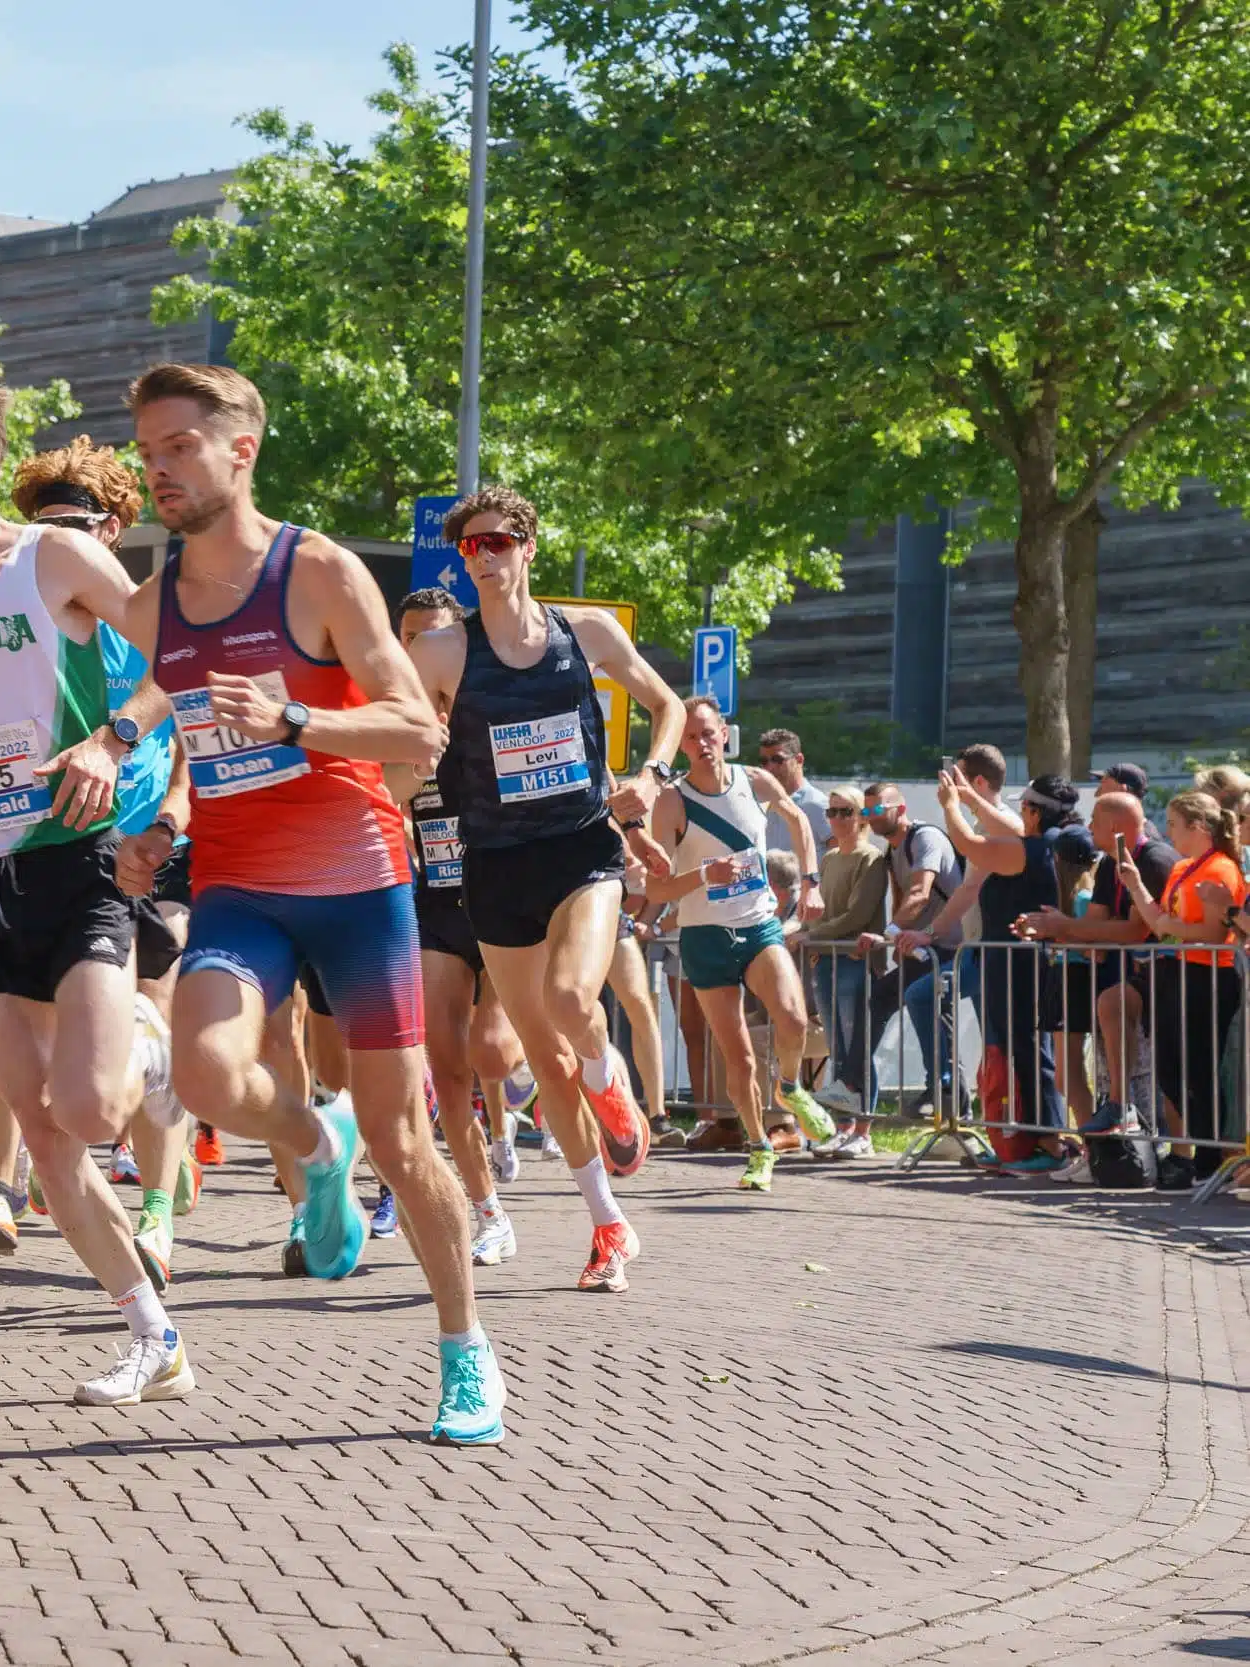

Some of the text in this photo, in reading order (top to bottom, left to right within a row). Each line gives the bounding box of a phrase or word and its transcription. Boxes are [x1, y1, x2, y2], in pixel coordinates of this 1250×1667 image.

[703, 635, 724, 680] P
[0, 741, 30, 757] 2022
[211, 726, 258, 752] 10
[495, 727, 575, 750] VENLOOP 2022
[525, 748, 558, 765] Levi
[214, 757, 274, 781] Daan
[521, 767, 569, 792] M151
[422, 831, 456, 840] VENLOO
[426, 842, 467, 859] M 12
